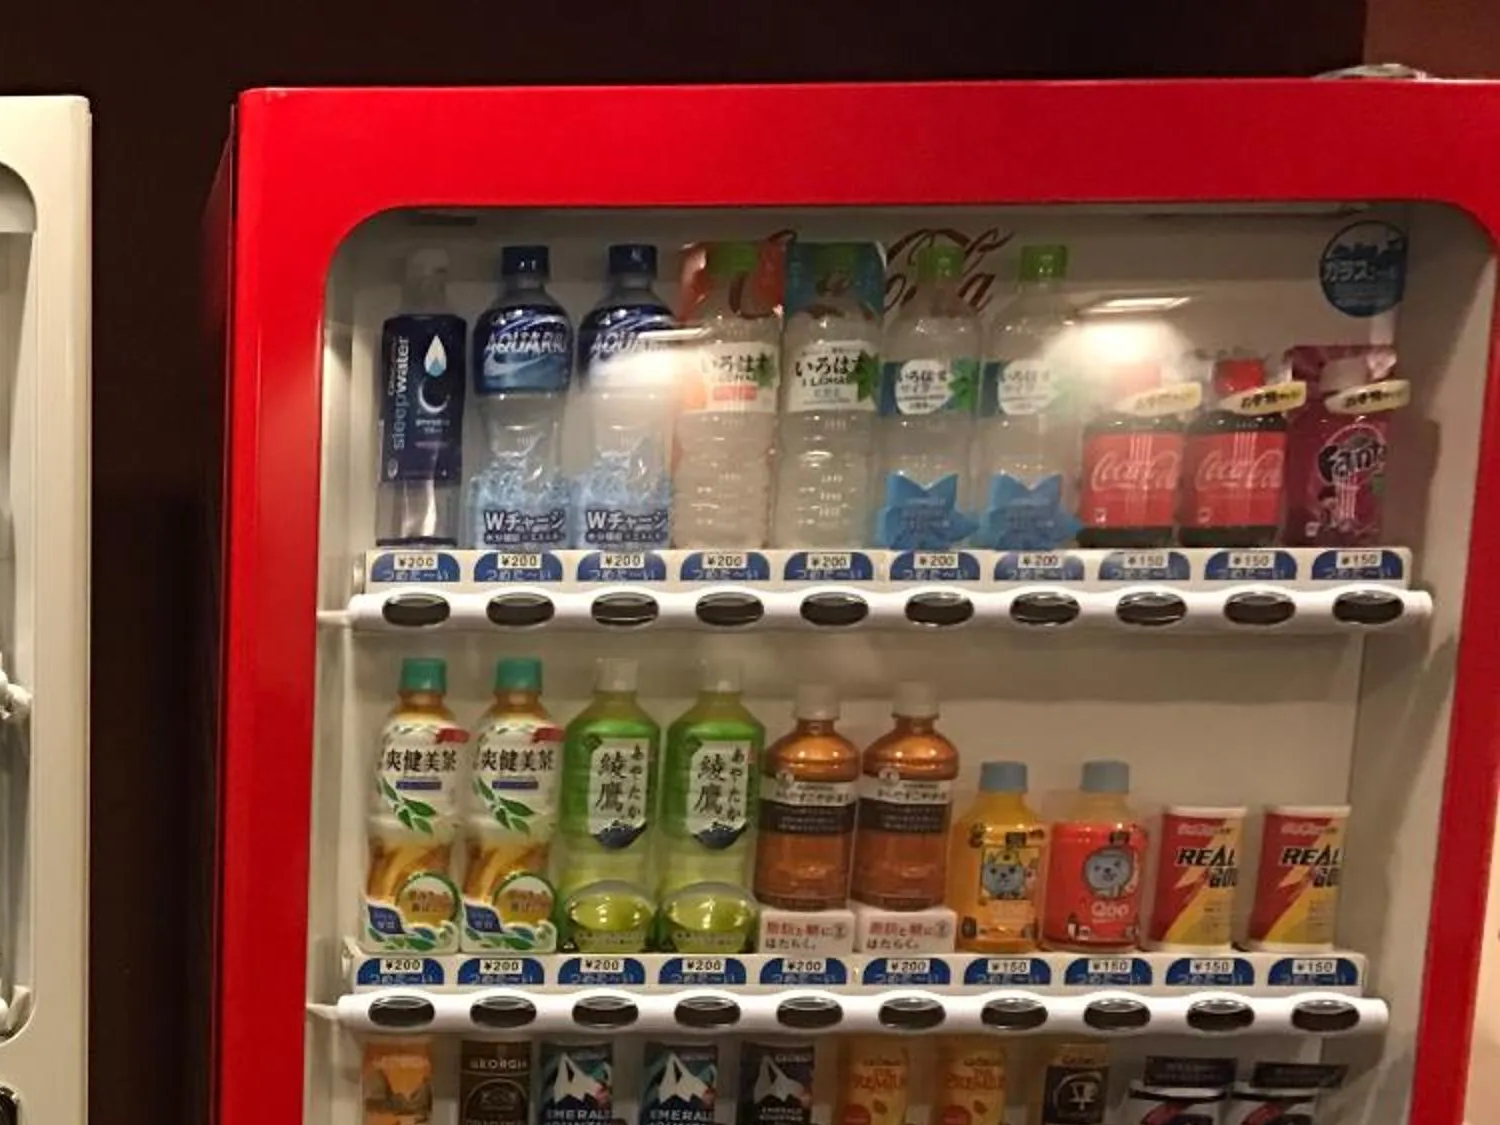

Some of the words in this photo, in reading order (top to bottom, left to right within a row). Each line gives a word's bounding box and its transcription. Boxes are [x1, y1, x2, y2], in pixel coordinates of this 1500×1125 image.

[385, 748, 457, 772] 爽健美茶
[481, 748, 554, 772] 爽健美茶
[1177, 844, 1237, 866] REAL
[1281, 844, 1341, 866] REAL
